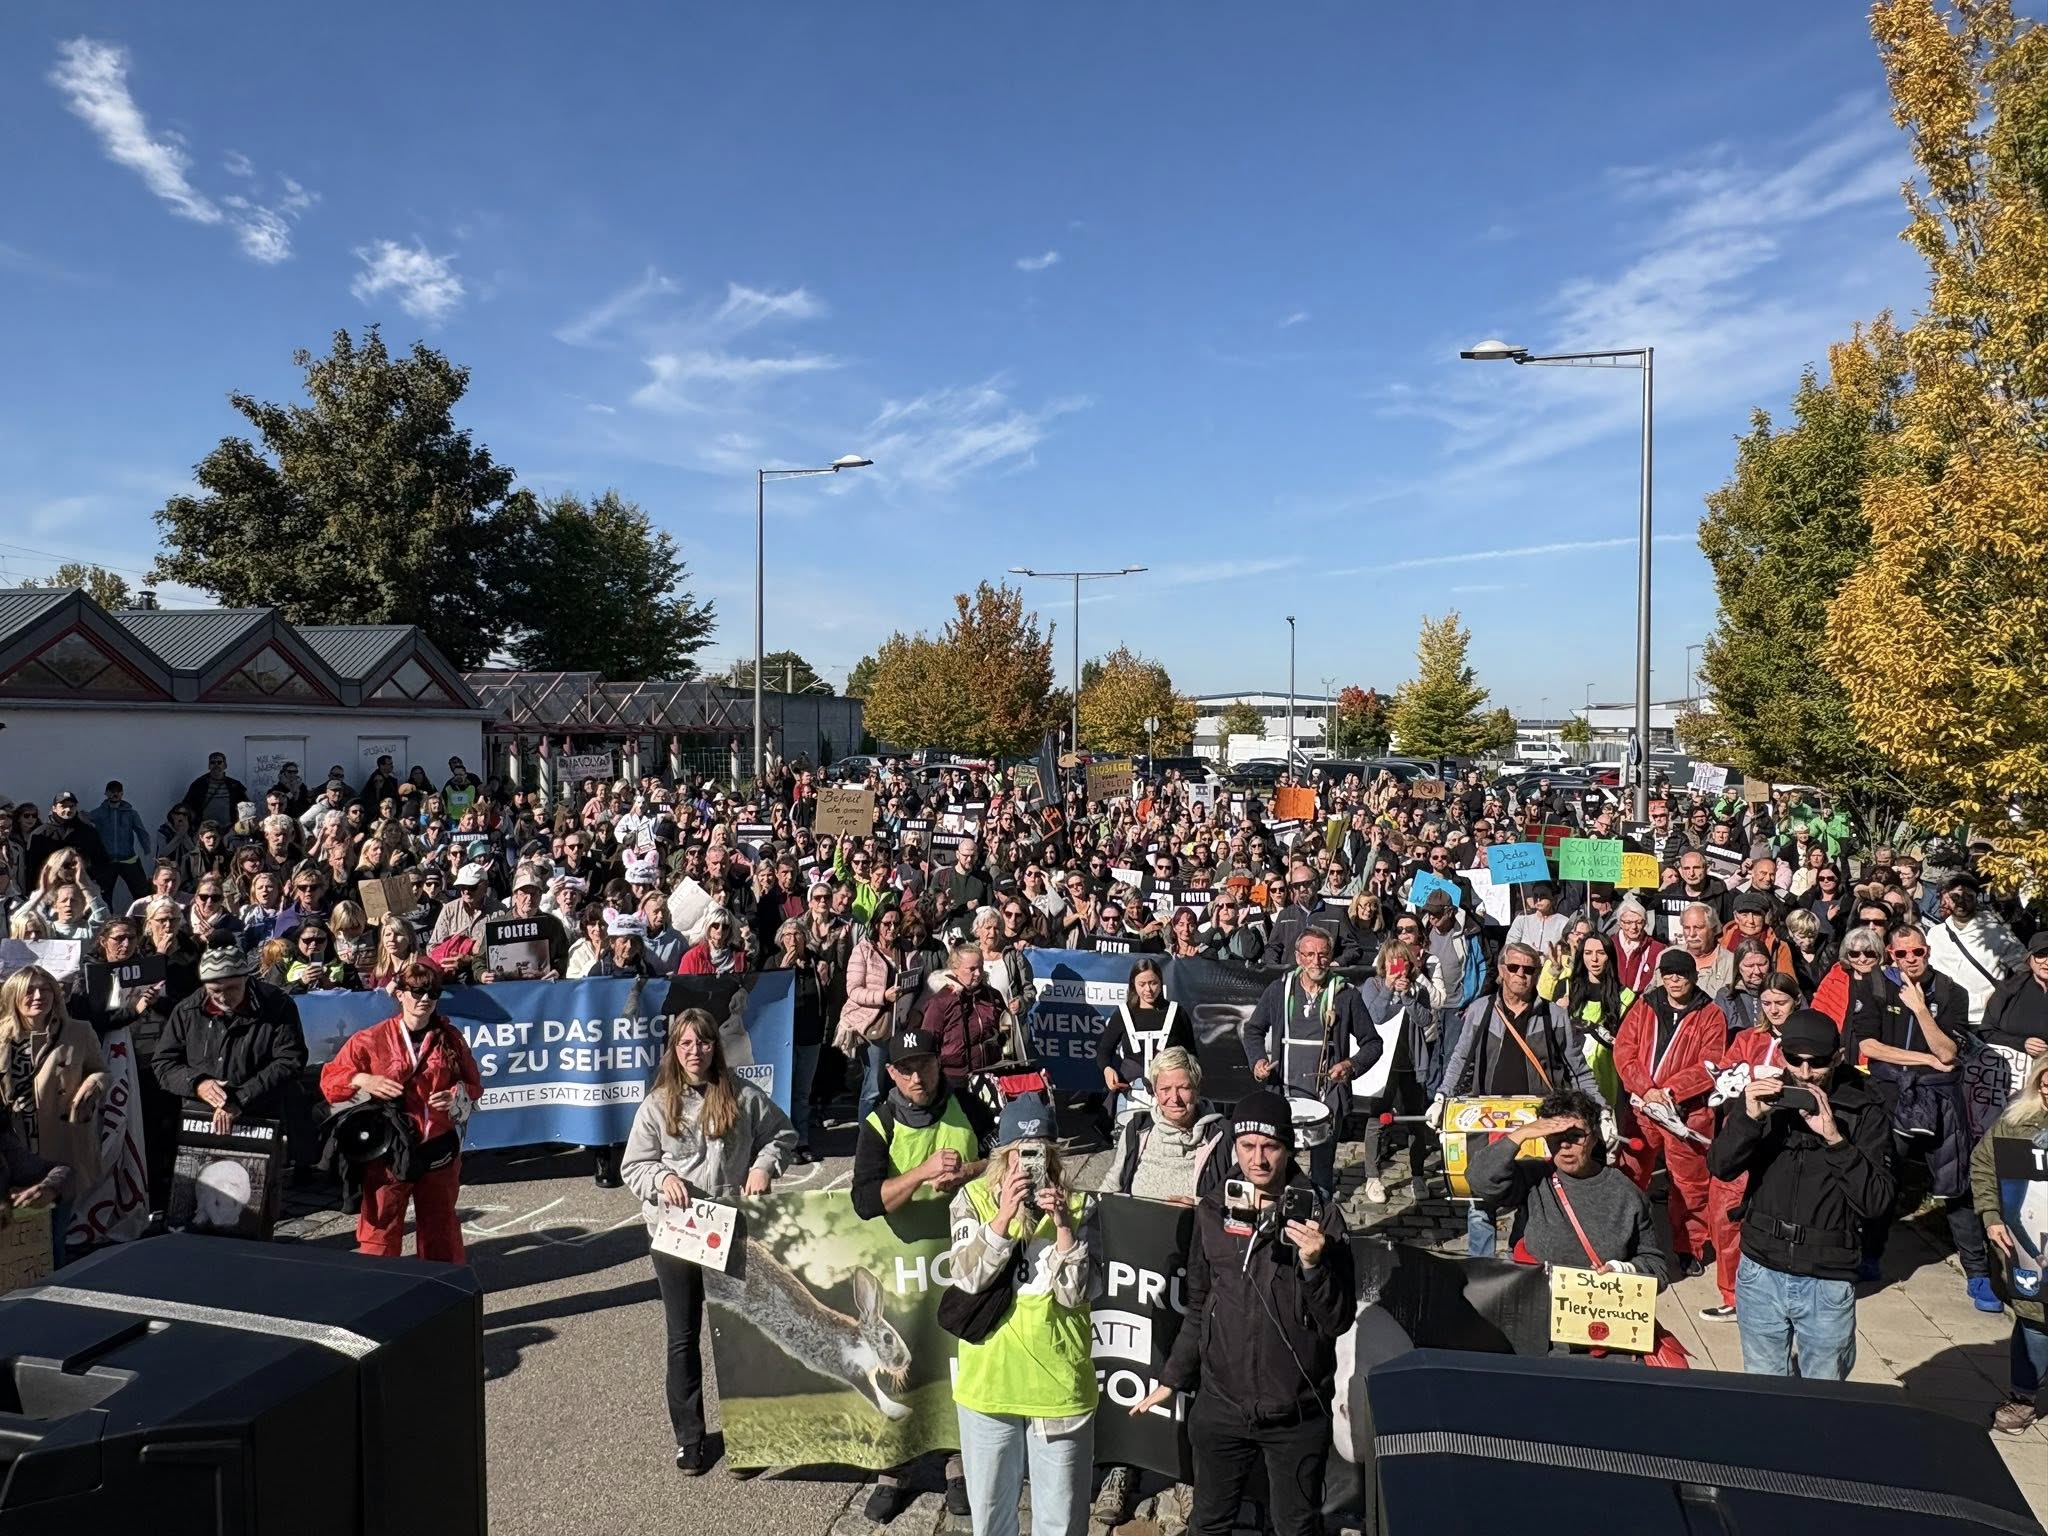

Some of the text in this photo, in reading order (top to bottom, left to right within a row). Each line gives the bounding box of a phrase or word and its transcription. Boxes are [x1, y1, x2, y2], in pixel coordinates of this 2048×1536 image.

[820, 791, 861, 805] Befreit
[836, 816, 858, 825] Tiere
[932, 835, 962, 844] AUSBEUT
[1155, 880, 1171, 891] TOD
[1180, 892, 1211, 903] FOLTER
[497, 923, 538, 940] FOLTER
[1095, 940, 1130, 954] FOLTER
[1043, 984, 1126, 1002] GEWALT, LE
[543, 1018, 603, 1043] DAS
[1033, 1012, 1108, 1035] MENS
[1033, 1037, 1098, 1059] RE ES
[508, 1048, 549, 1074] ZU
[737, 1066, 773, 1079] SOKO
[480, 1085, 640, 1106] EBATTE STATT ZENSUR
[182, 1119, 274, 1140] VERSTMELUNG
[1576, 1272, 1624, 1295] Stopt
[1554, 1296, 1650, 1323] Tierversuche
[1091, 1321, 1141, 1349] ATT
